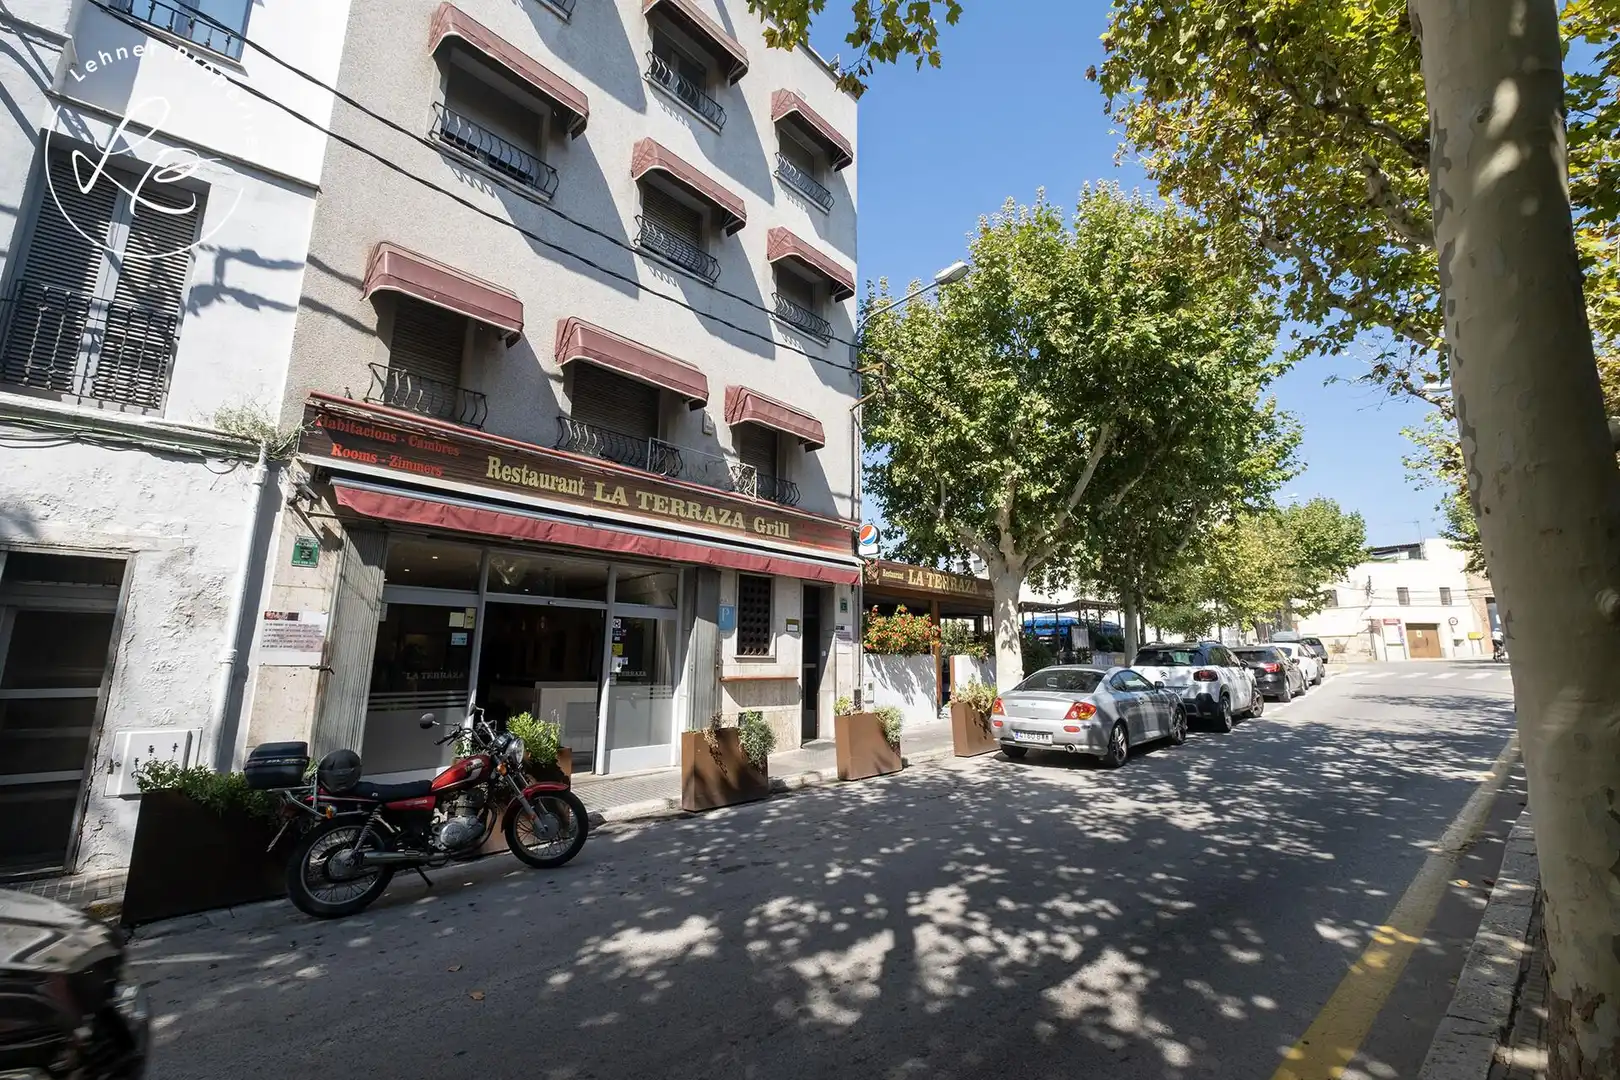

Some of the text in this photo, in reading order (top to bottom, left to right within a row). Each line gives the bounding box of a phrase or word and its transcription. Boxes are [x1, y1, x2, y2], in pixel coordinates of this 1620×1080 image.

[330, 442, 378, 464] Rooms
[388, 454, 443, 478] Zimmers
[408, 435, 461, 457] Cambres
[485, 455, 790, 538] Restaurant LA TERRAZA Grill
[907, 569, 925, 587] LA
